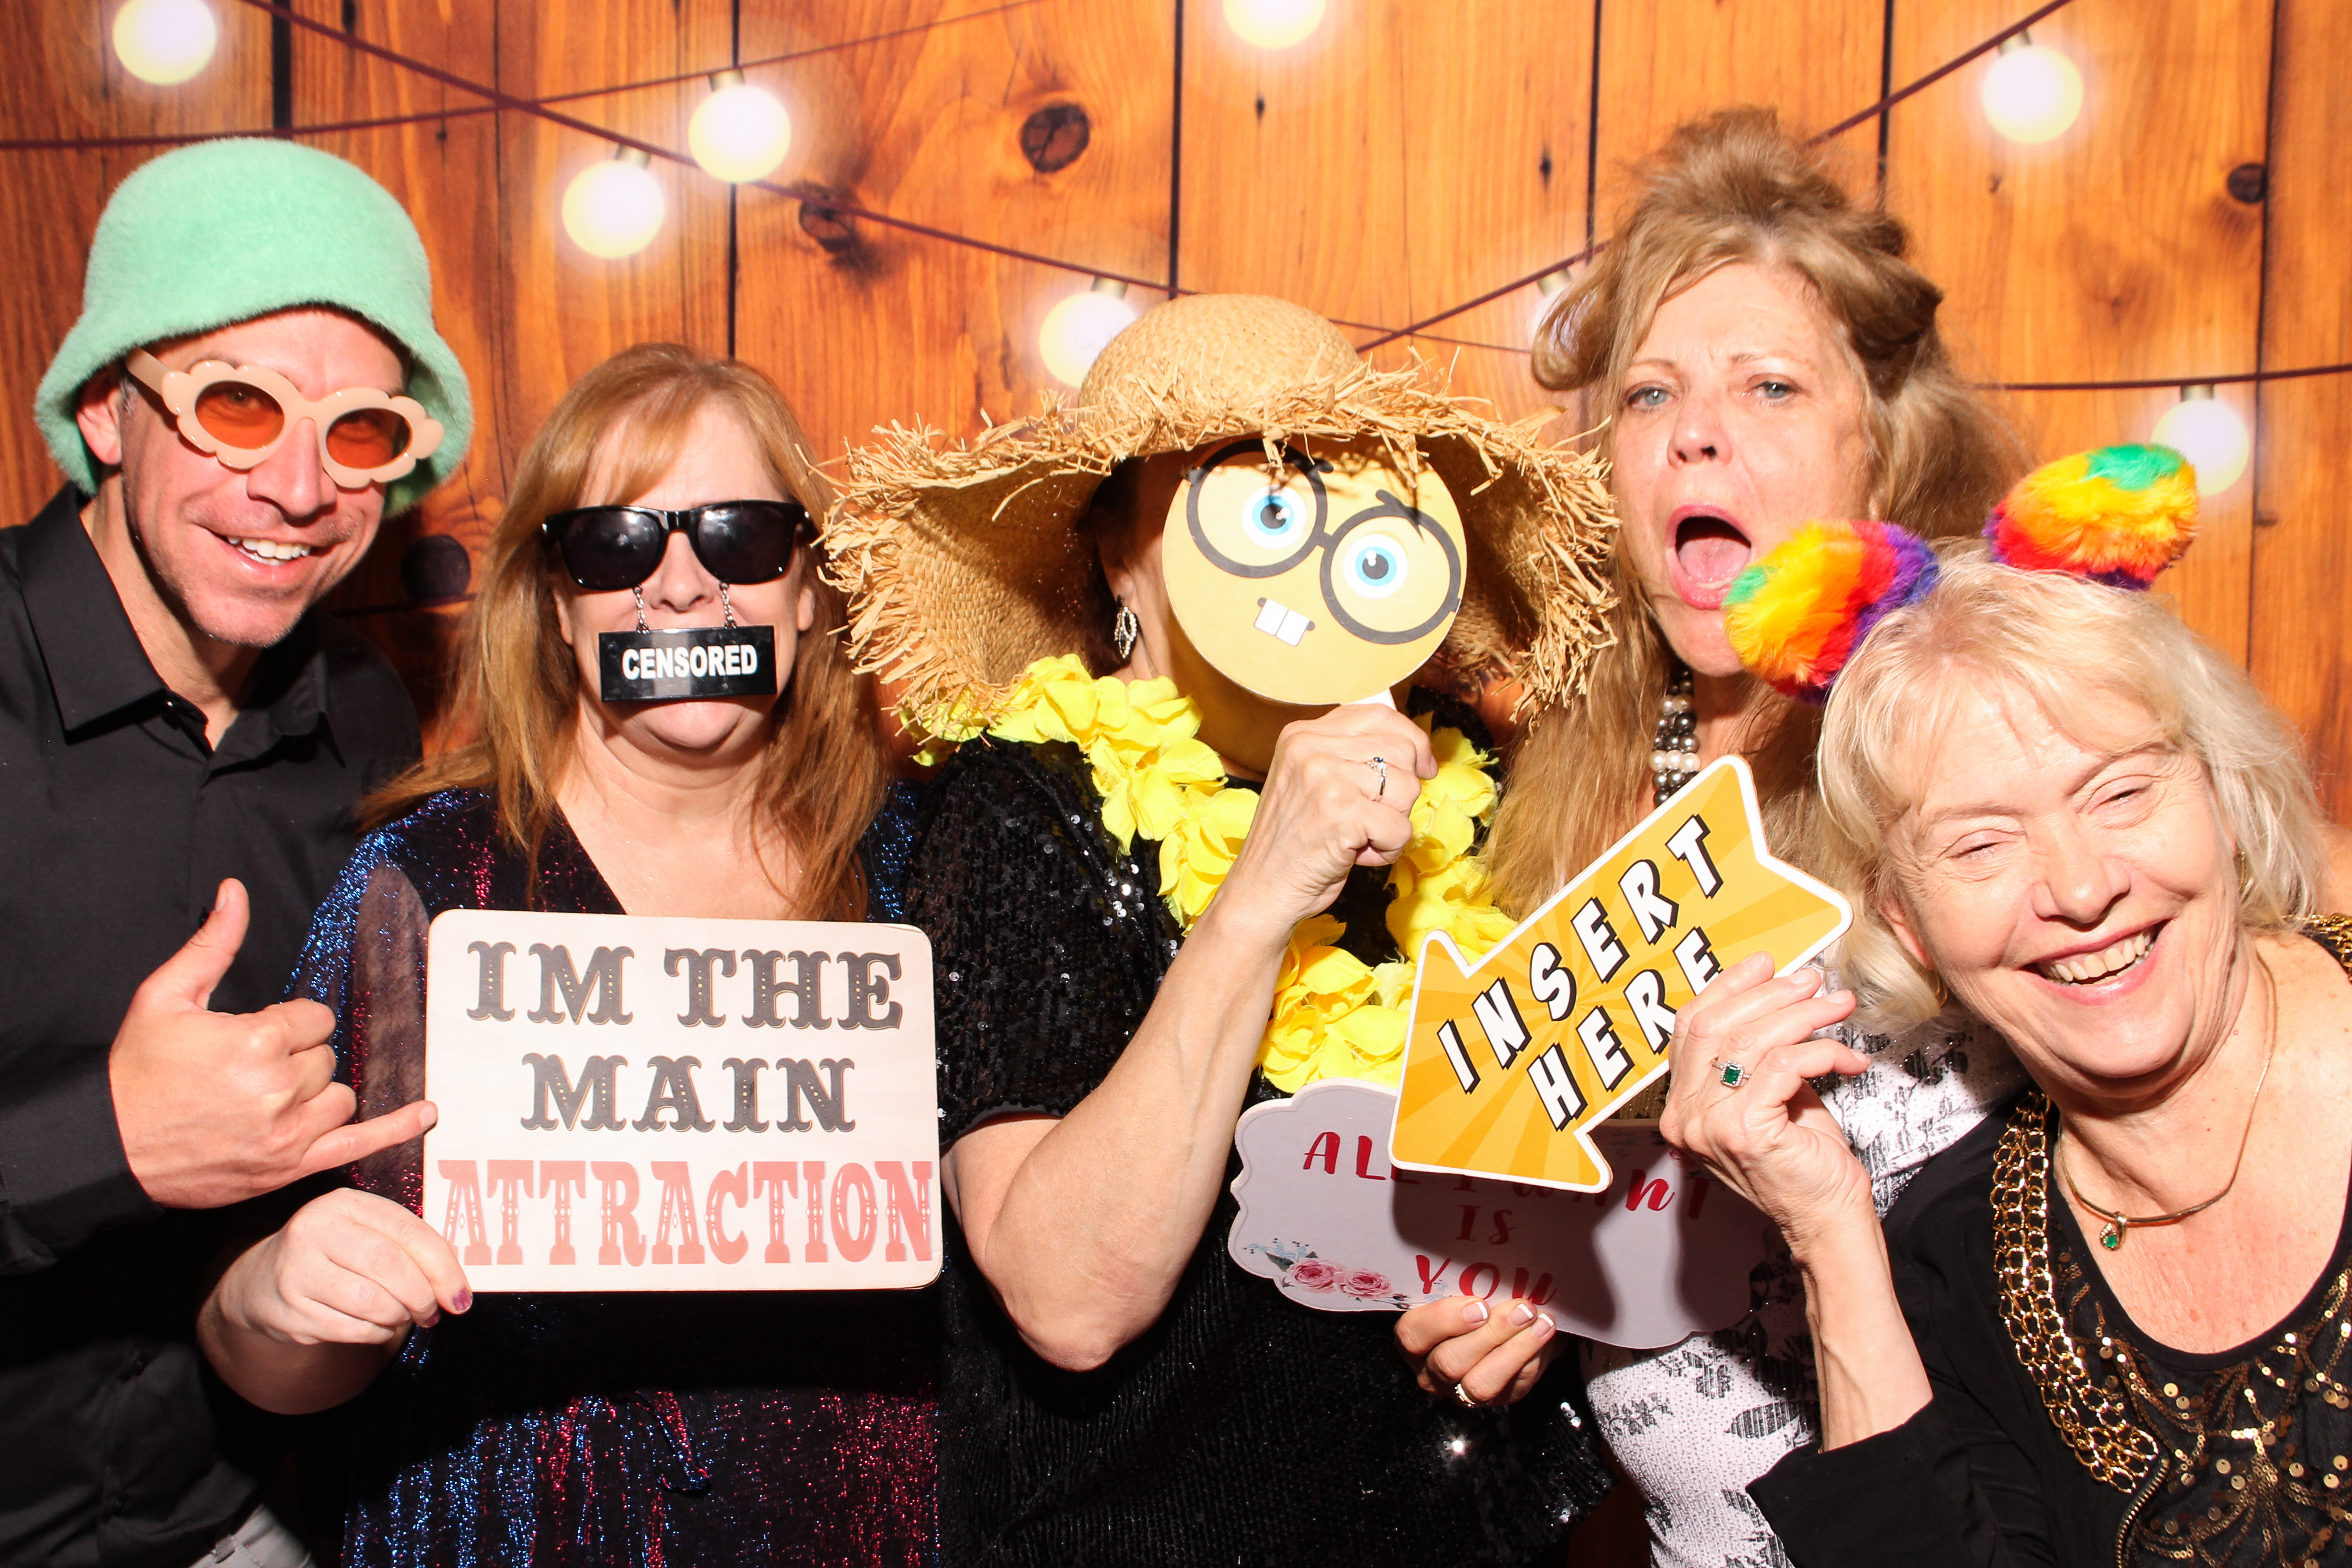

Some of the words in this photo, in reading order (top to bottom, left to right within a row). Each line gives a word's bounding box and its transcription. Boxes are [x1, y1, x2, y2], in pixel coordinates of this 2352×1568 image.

[622, 644, 758, 680] CENSORED
[467, 940, 634, 1025] IM
[664, 946, 903, 1031] THE
[1437, 814, 1724, 1093] INSERT
[1527, 926, 1724, 1132] HERE
[520, 1053, 856, 1133] MAIN
[438, 1159, 933, 1267] ATTRACTION
